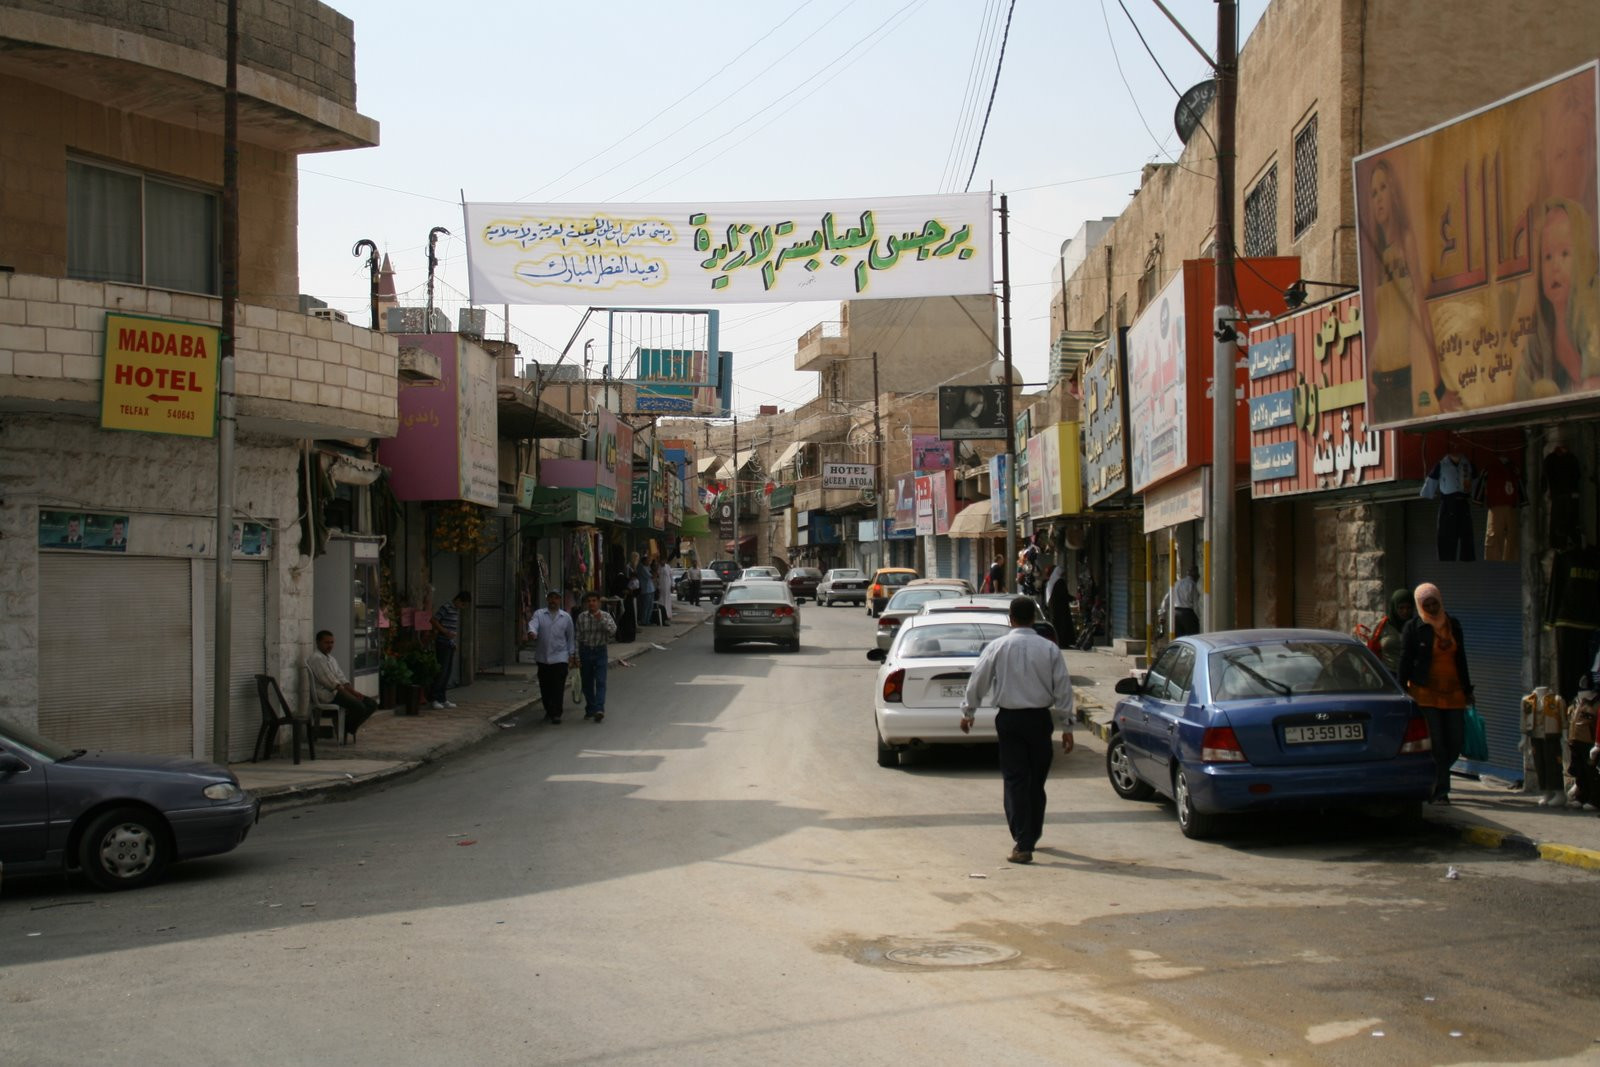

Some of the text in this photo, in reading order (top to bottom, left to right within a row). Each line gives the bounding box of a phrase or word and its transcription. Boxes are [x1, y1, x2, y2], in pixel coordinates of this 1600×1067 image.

[868, 219, 973, 271] برجس
[515, 255, 660, 285] بعيد الفطر المبارك
[118, 328, 207, 358] MADABA
[115, 364, 203, 392] HOTEL
[120, 405, 195, 421] TELFAX 540643
[823, 476, 847, 487] QUEEN
[830, 466, 868, 475] HOTEL
